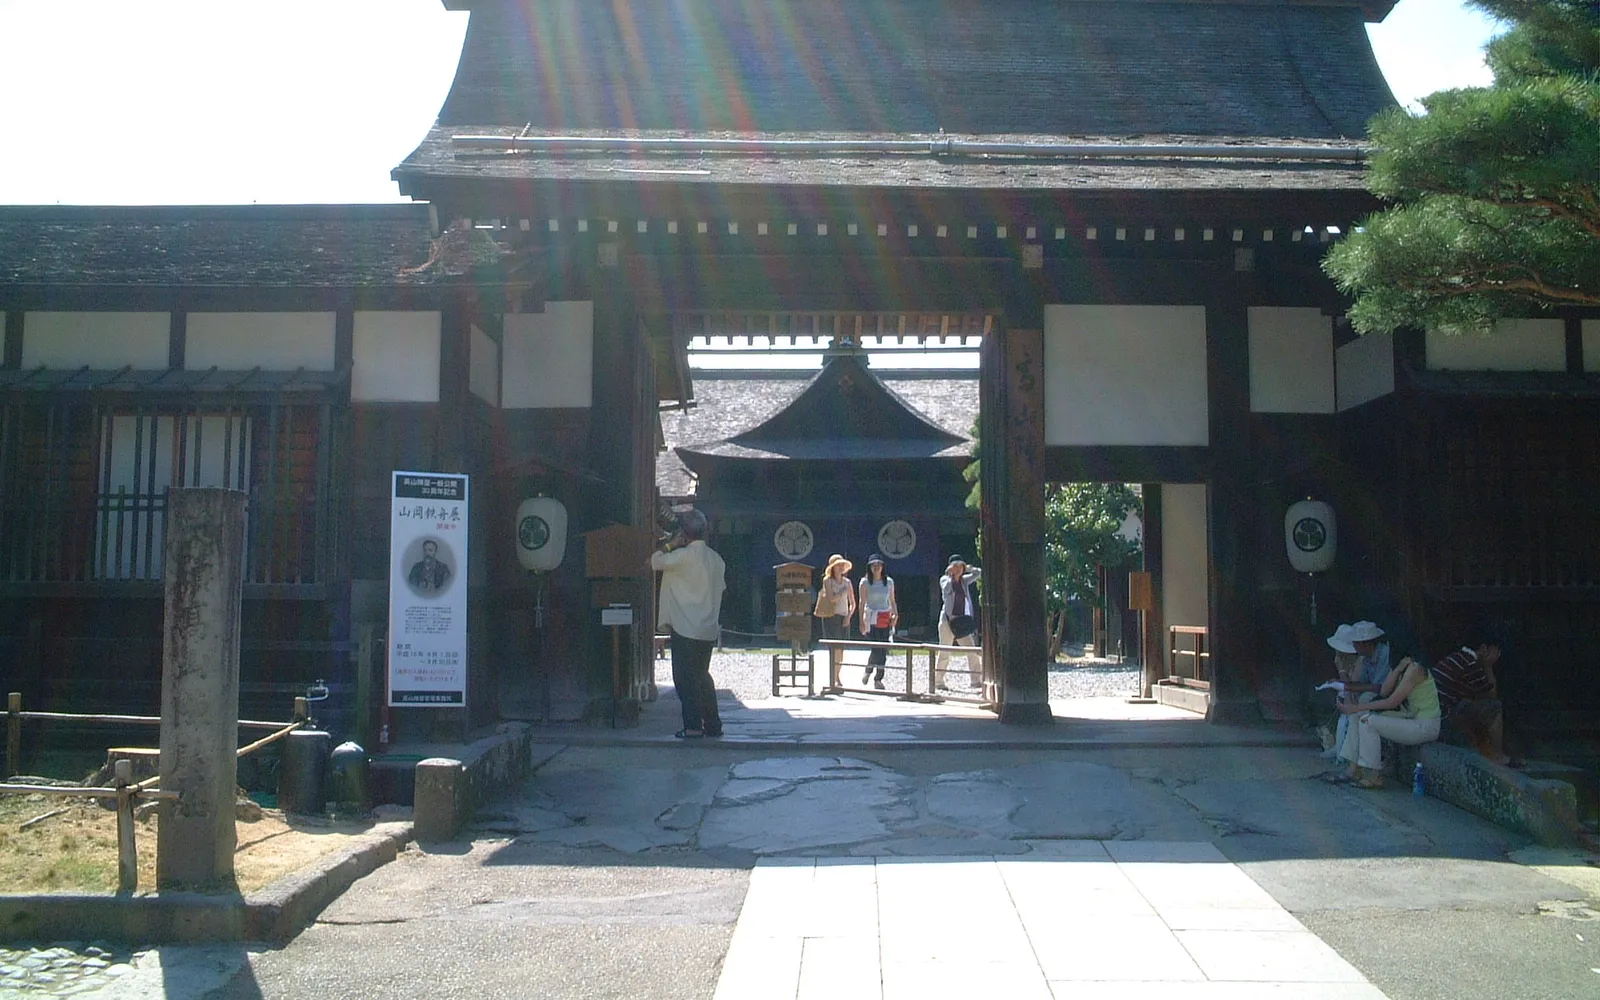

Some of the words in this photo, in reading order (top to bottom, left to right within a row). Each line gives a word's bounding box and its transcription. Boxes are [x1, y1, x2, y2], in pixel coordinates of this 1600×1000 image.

[399, 505, 460, 521] 山岡鉄舟展
